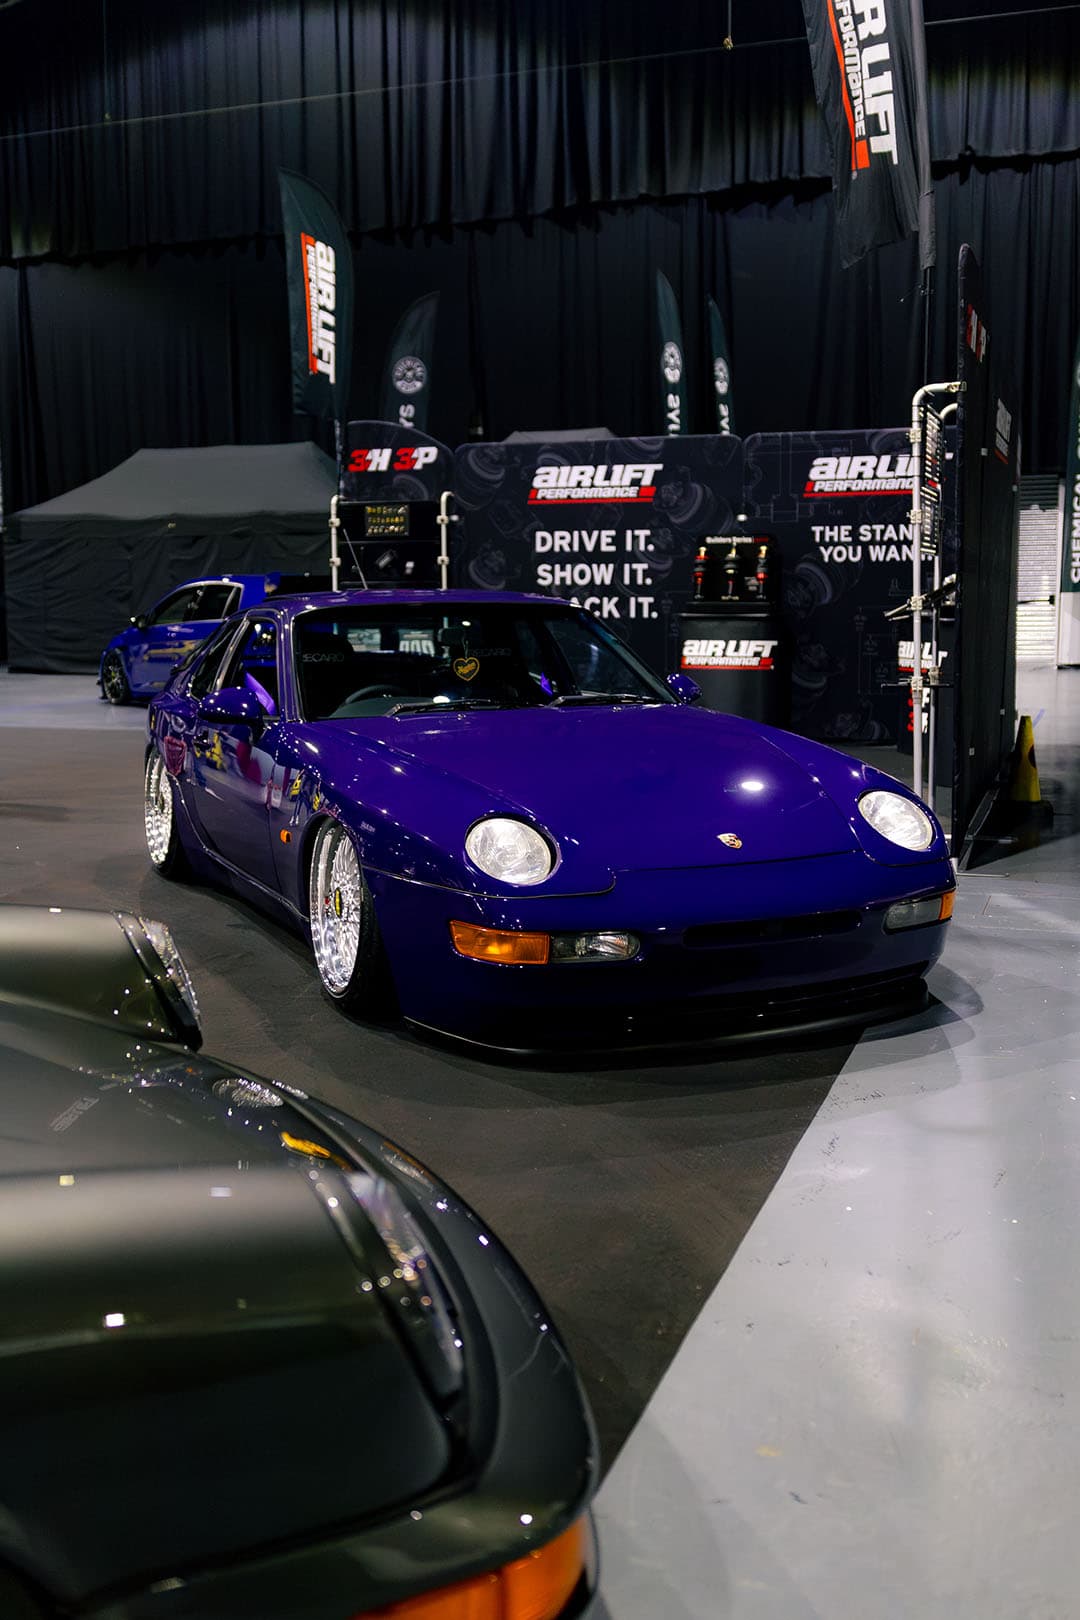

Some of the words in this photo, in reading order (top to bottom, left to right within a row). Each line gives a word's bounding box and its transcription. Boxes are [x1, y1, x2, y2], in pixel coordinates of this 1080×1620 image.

[348, 448, 392, 472] 3H
[393, 446, 438, 471] 3P
[809, 453, 914, 481] AIRLI
[535, 530, 616, 552] DRIVE
[625, 529, 655, 552] IT.
[811, 526, 853, 543] THE
[859, 524, 914, 542] STAN
[819, 545, 862, 562] YOU
[536, 563, 615, 586] SHOW
[623, 563, 653, 586] IT.
[629, 596, 659, 619] IT.
